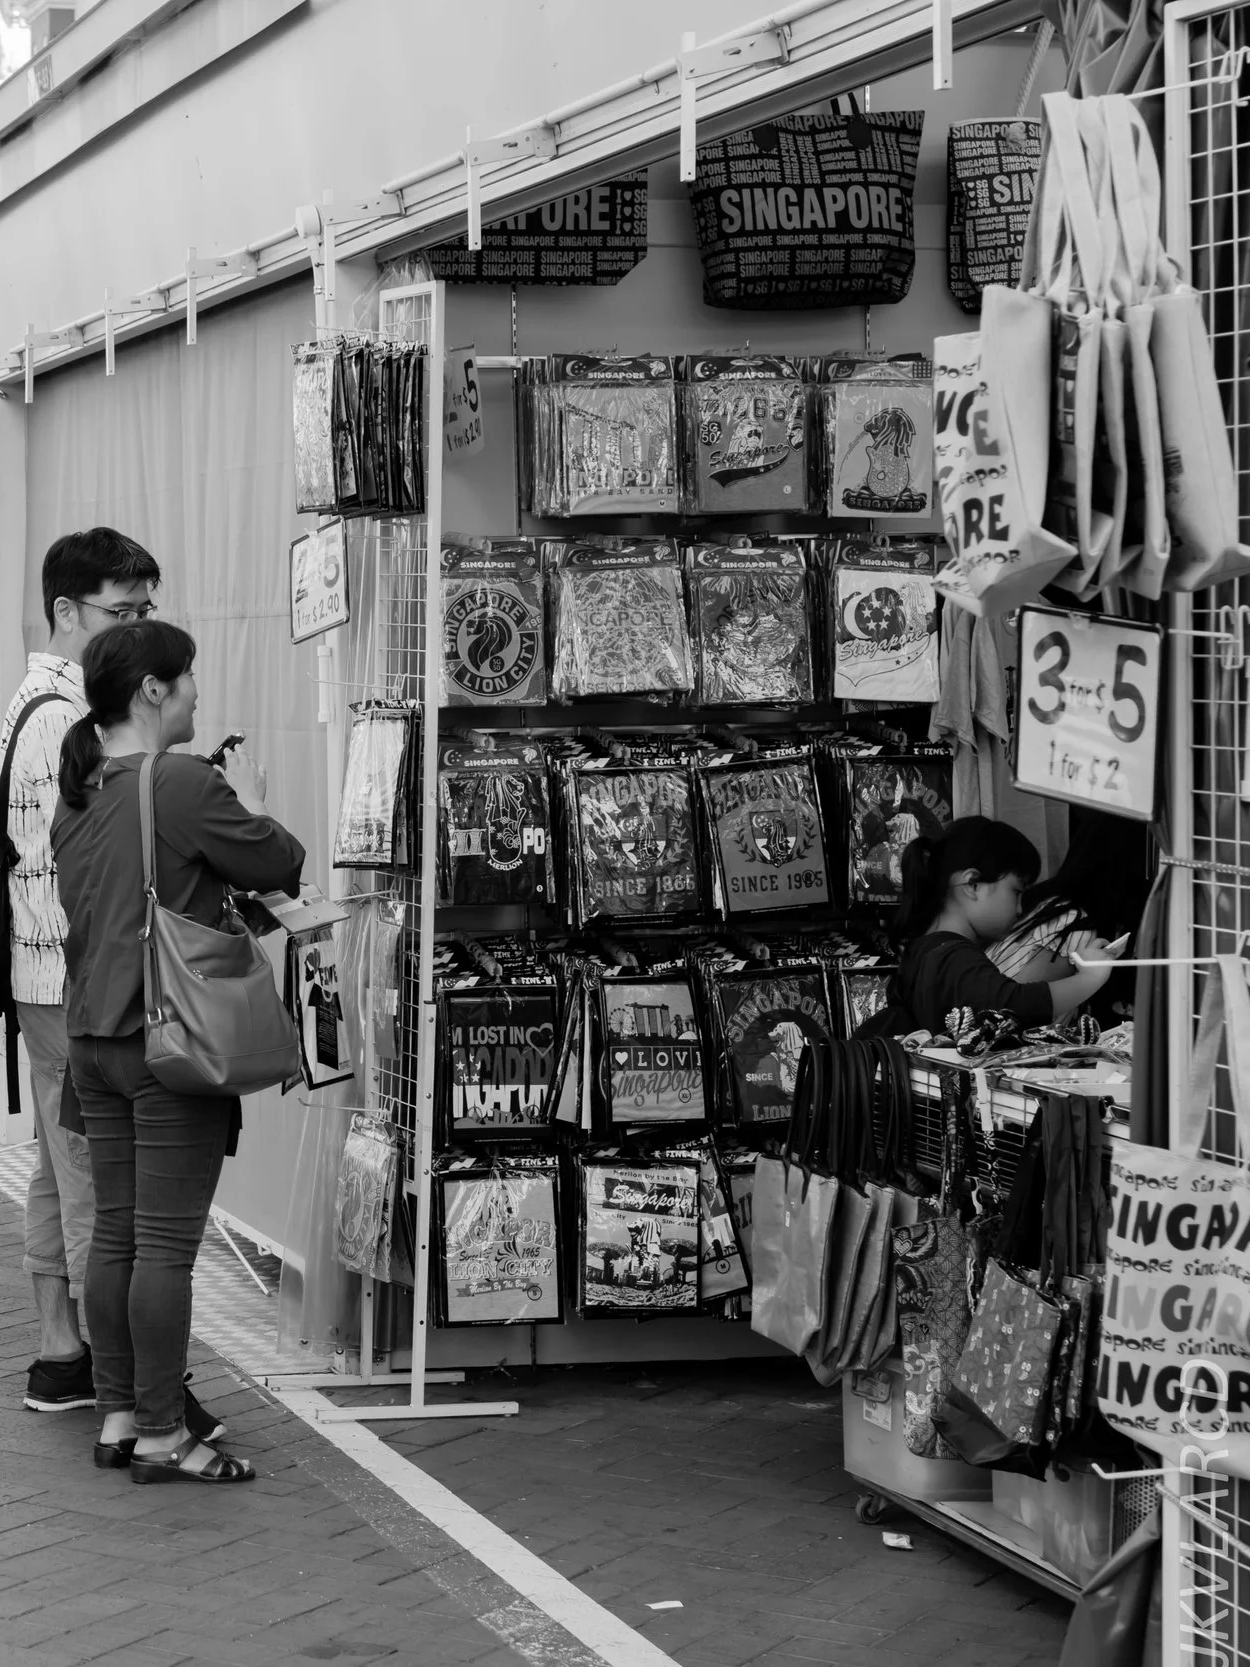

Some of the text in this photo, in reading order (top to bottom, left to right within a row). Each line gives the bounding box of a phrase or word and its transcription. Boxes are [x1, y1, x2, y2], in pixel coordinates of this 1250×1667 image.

[953, 140, 996, 150] SINGAPORE
[954, 147, 997, 159] SINGAPORE
[730, 158, 780, 172] SINGAPORE
[955, 157, 999, 169] SINGAPORE
[731, 171, 782, 185] SINGAPORE
[956, 165, 1000, 178] SINGAPORE
[976, 180, 988, 188] SG
[634, 189, 647, 203] SG
[977, 189, 989, 197] SG
[720, 185, 903, 233] SINGAPORE
[978, 198, 990, 207] SG
[634, 205, 647, 219] SG
[634, 220, 647, 235] SG
[511, 236, 555, 247] SINGAPORE
[559, 236, 602, 247] SINGAPORE
[729, 235, 773, 248] SINGAPORE
[776, 234, 819, 246] SINGAPORE
[823, 234, 864, 245] SINGAPORE
[483, 251, 535, 263] SINGAPORE
[541, 252, 593, 264] SINGAPORE
[597, 252, 634, 261] SINGAPORE
[739, 250, 845, 265] SINGAPORE SINGAPORE
[482, 264, 535, 276] SINGAPORE
[540, 264, 593, 277] SINGAPORE
[740, 263, 844, 277] SINGAPORE SINGAPORE
[968, 263, 1008, 275] SINGAPORE
[701, 422, 718, 432] SG
[702, 433, 717, 443] 50
[460, 561, 517, 569] SINGAPORE
[591, 556, 650, 565] SINGAPORE
[720, 561, 778, 569] SINGAPORE
[859, 558, 911, 568] SINGAPORE
[838, 629, 925, 661] Singapore
[463, 637, 535, 692] LION CITY
[1028, 631, 1071, 725] 3
[464, 758, 519, 767] SINGAPORE
[1049, 739, 1056, 776] 1
[1062, 753, 1082, 779] for
[486, 859, 524, 871] MERLION
[594, 878, 647, 898] SINCE
[731, 874, 779, 893] SINCE
[469, 1026, 507, 1045] LOST
[510, 1026, 525, 1045] IN
[745, 1073, 773, 1082] SINCE
[752, 1104, 792, 1121] LION
[609, 1184, 690, 1210] Singapore
[449, 1262, 498, 1280] LION
